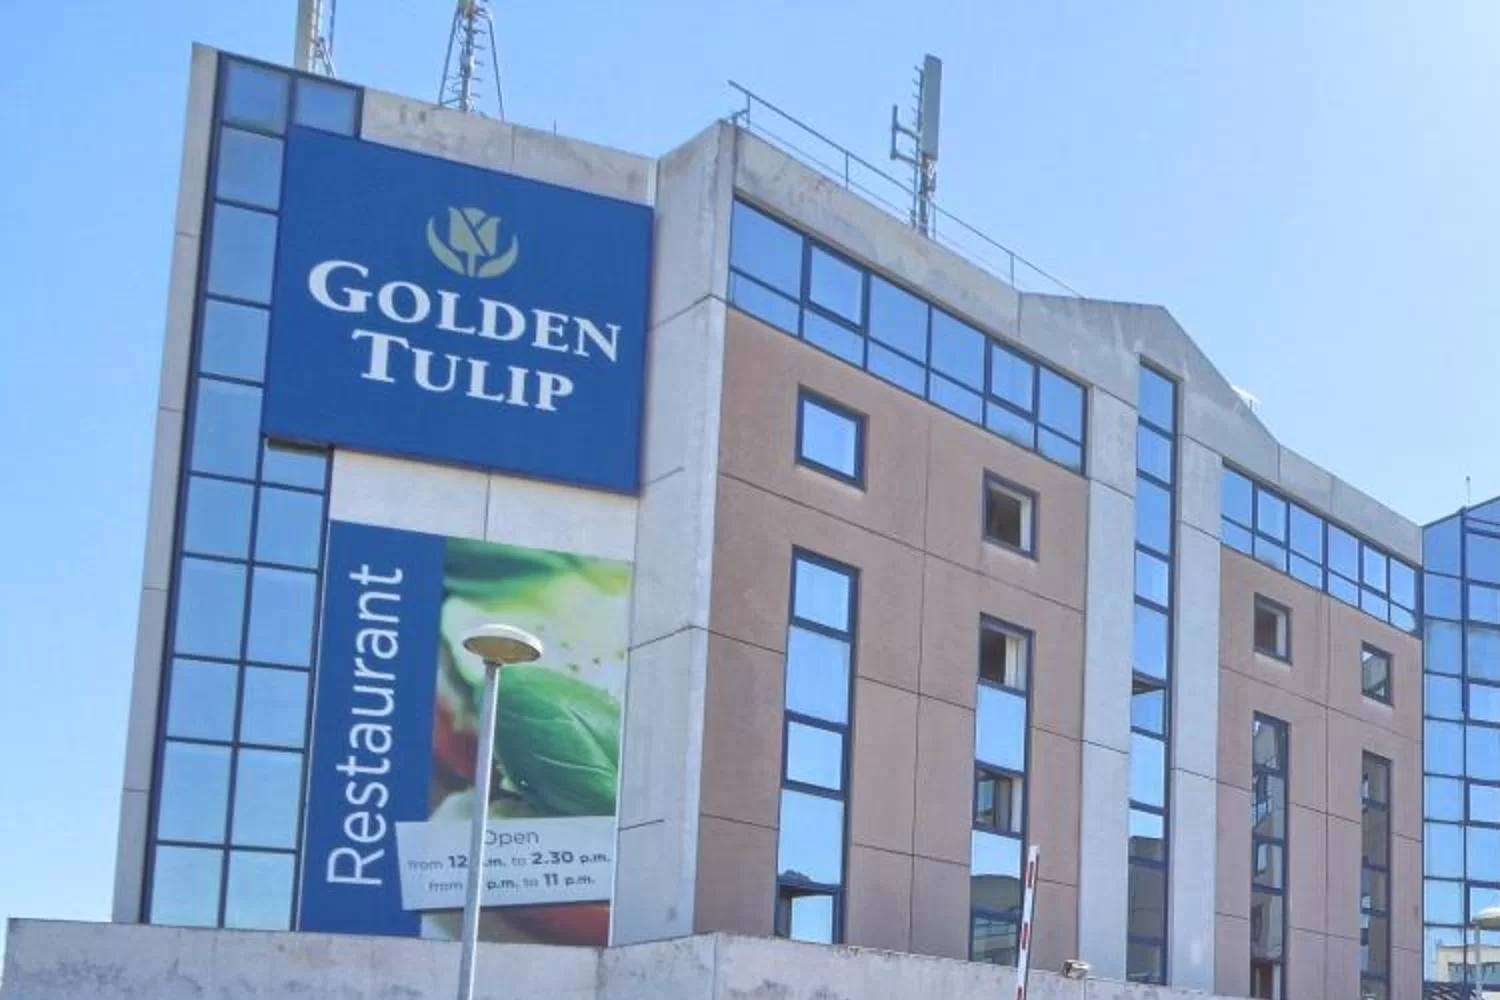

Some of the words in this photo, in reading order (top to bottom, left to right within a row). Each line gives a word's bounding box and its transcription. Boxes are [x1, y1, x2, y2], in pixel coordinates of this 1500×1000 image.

[308, 259, 622, 363] GOLDEN
[351, 329, 574, 412] TULIP
[327, 563, 403, 886] Restaurant
[408, 858, 443, 871] from
[448, 855, 467, 869] 12
[511, 856, 527, 866] to
[531, 851, 574, 865] 2.30
[579, 852, 612, 865] p.m.
[428, 880, 463, 893] from
[543, 873, 559, 887] 11
[564, 875, 596, 887] p.m.
